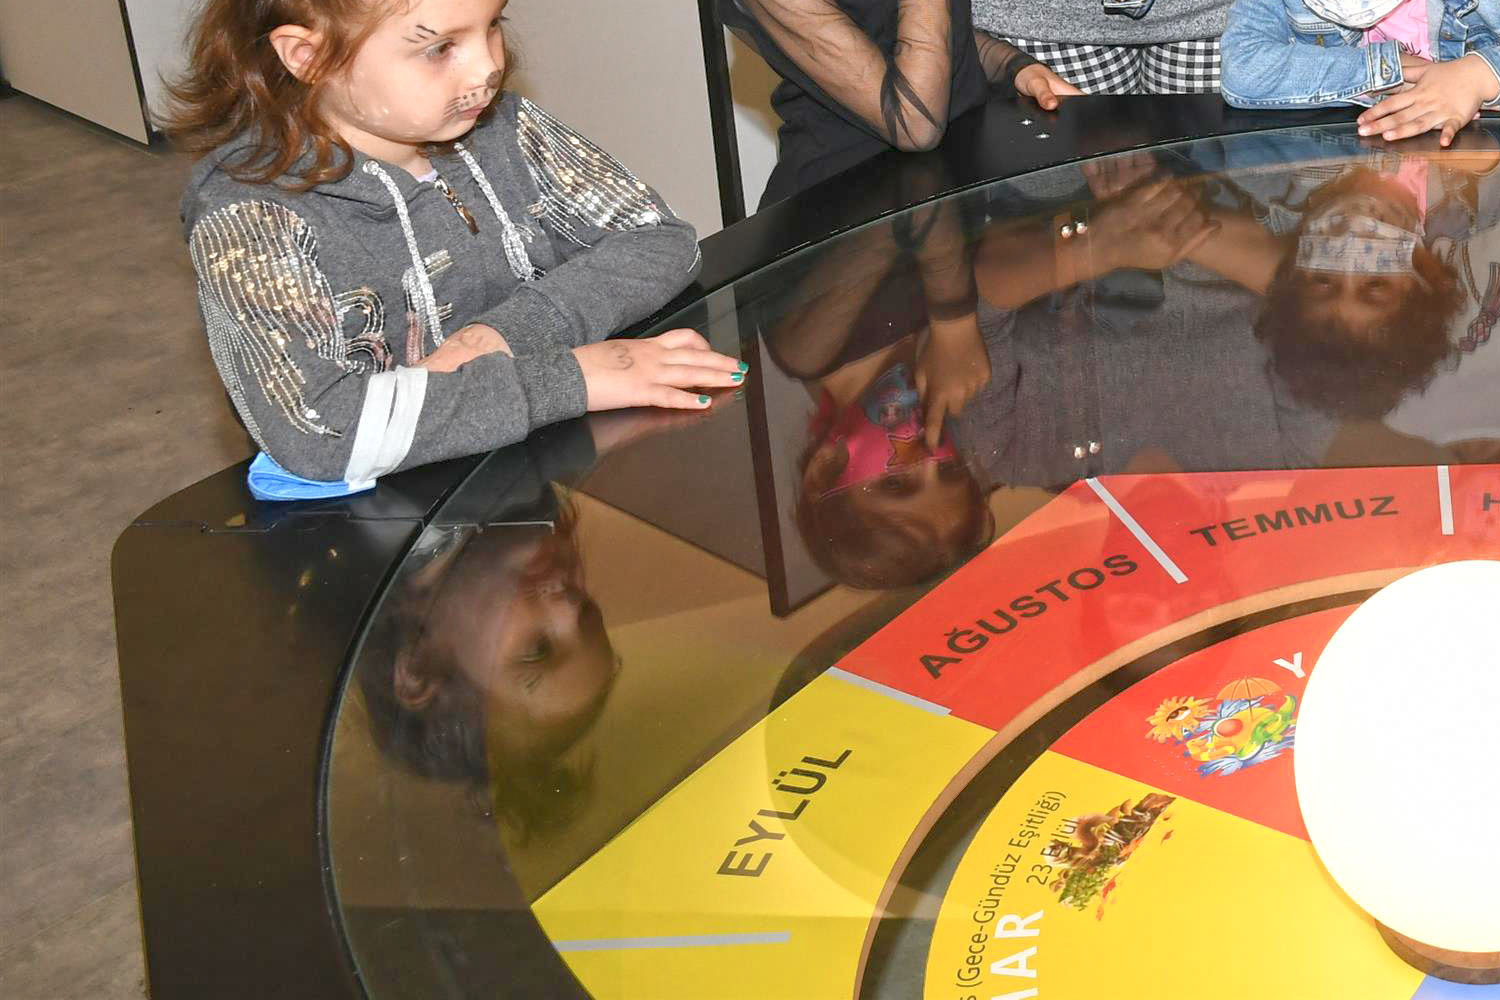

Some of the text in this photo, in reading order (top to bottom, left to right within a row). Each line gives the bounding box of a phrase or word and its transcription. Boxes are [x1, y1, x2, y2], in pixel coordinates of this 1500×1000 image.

[1189, 495, 1400, 547] TEMMUZ
[919, 554, 1139, 680] AĞUSTOS
[716, 749, 853, 878] EYLÜL
[1026, 864, 1054, 886] 23
[956, 791, 1068, 988] (Gece-Gündüz Eşitliği)
